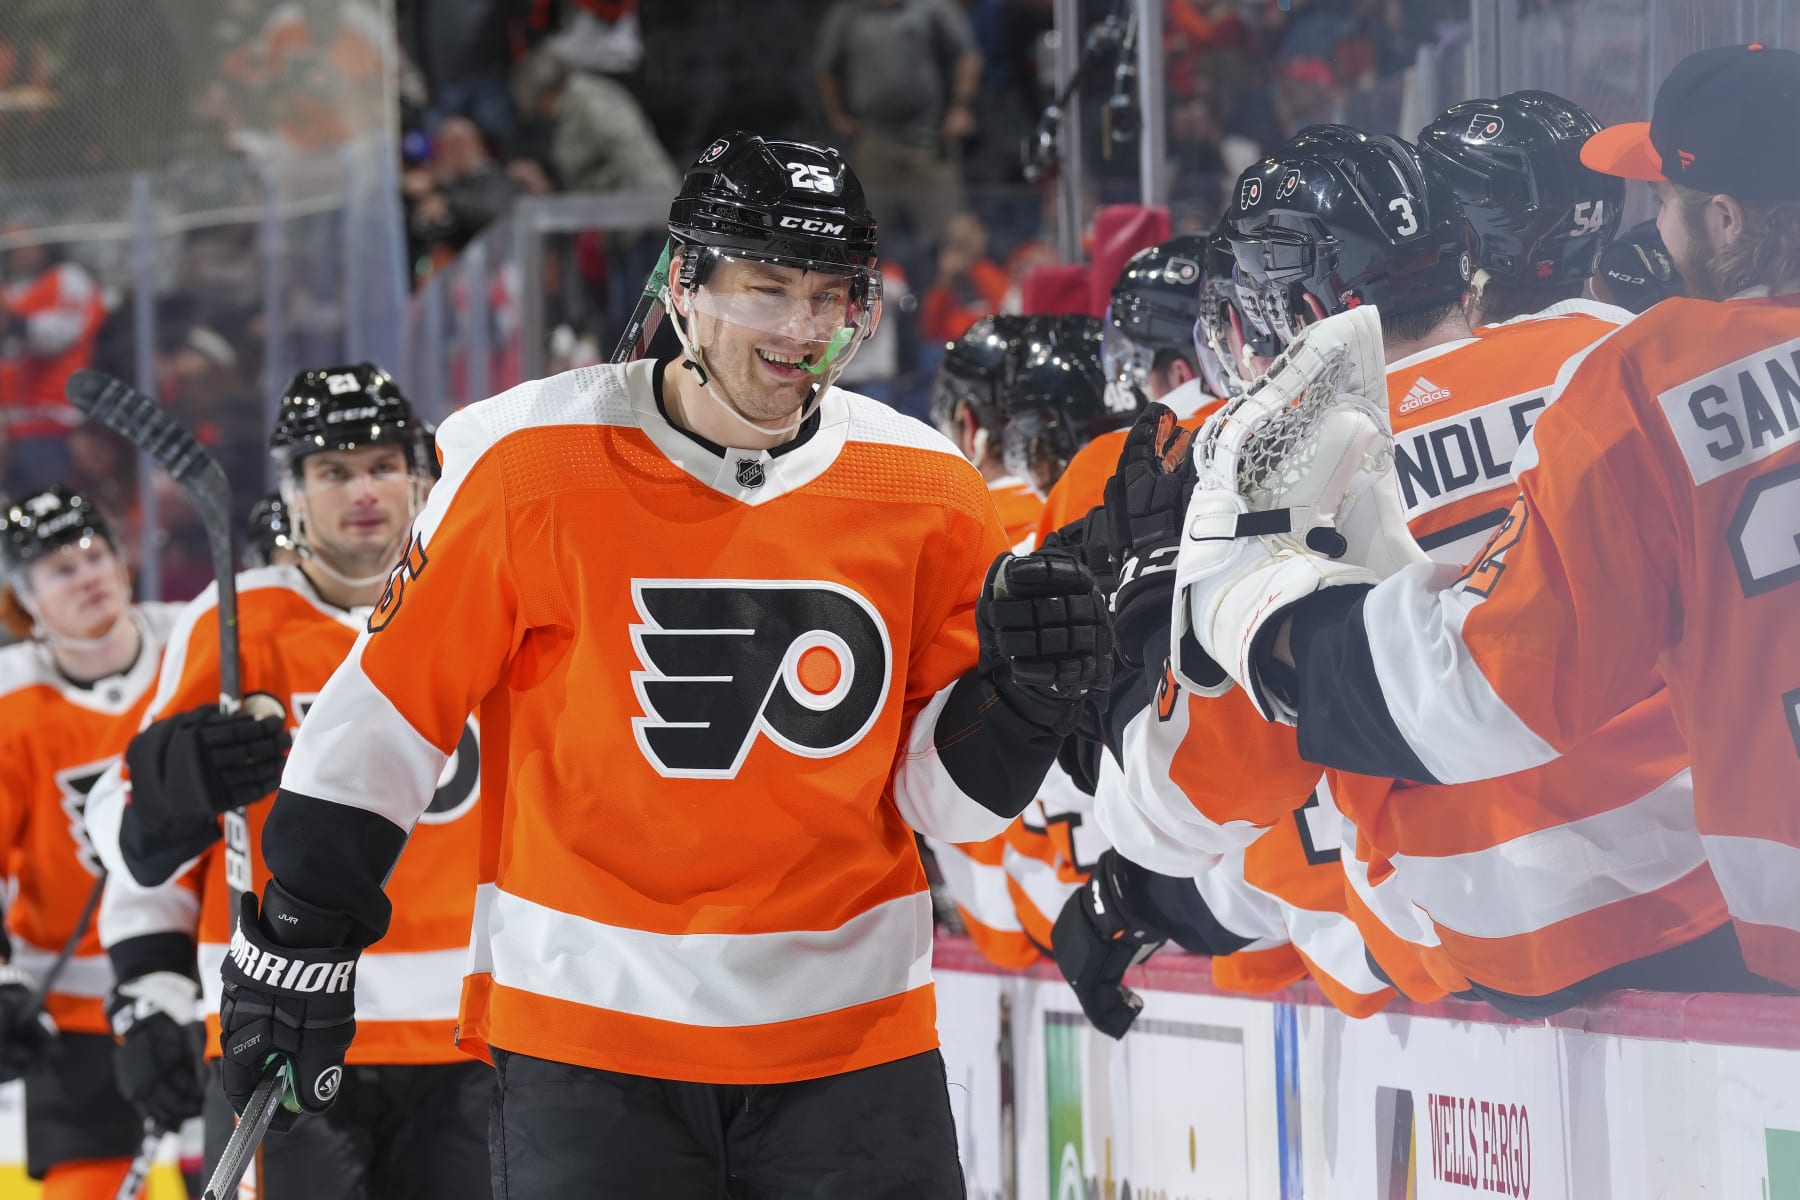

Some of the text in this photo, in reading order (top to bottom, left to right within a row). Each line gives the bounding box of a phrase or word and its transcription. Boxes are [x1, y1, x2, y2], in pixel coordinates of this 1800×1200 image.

[786, 161, 836, 193] 25
[779, 215, 845, 236] CCM
[1388, 197, 1418, 236] 3
[1570, 200, 1604, 237] 54
[1608, 270, 1646, 286] CCM
[1399, 388, 1450, 413] adidas
[742, 466, 760, 483] NHL
[232, 1034, 261, 1055] COVERT
[1428, 1093, 1531, 1200] WELLS FARGO
